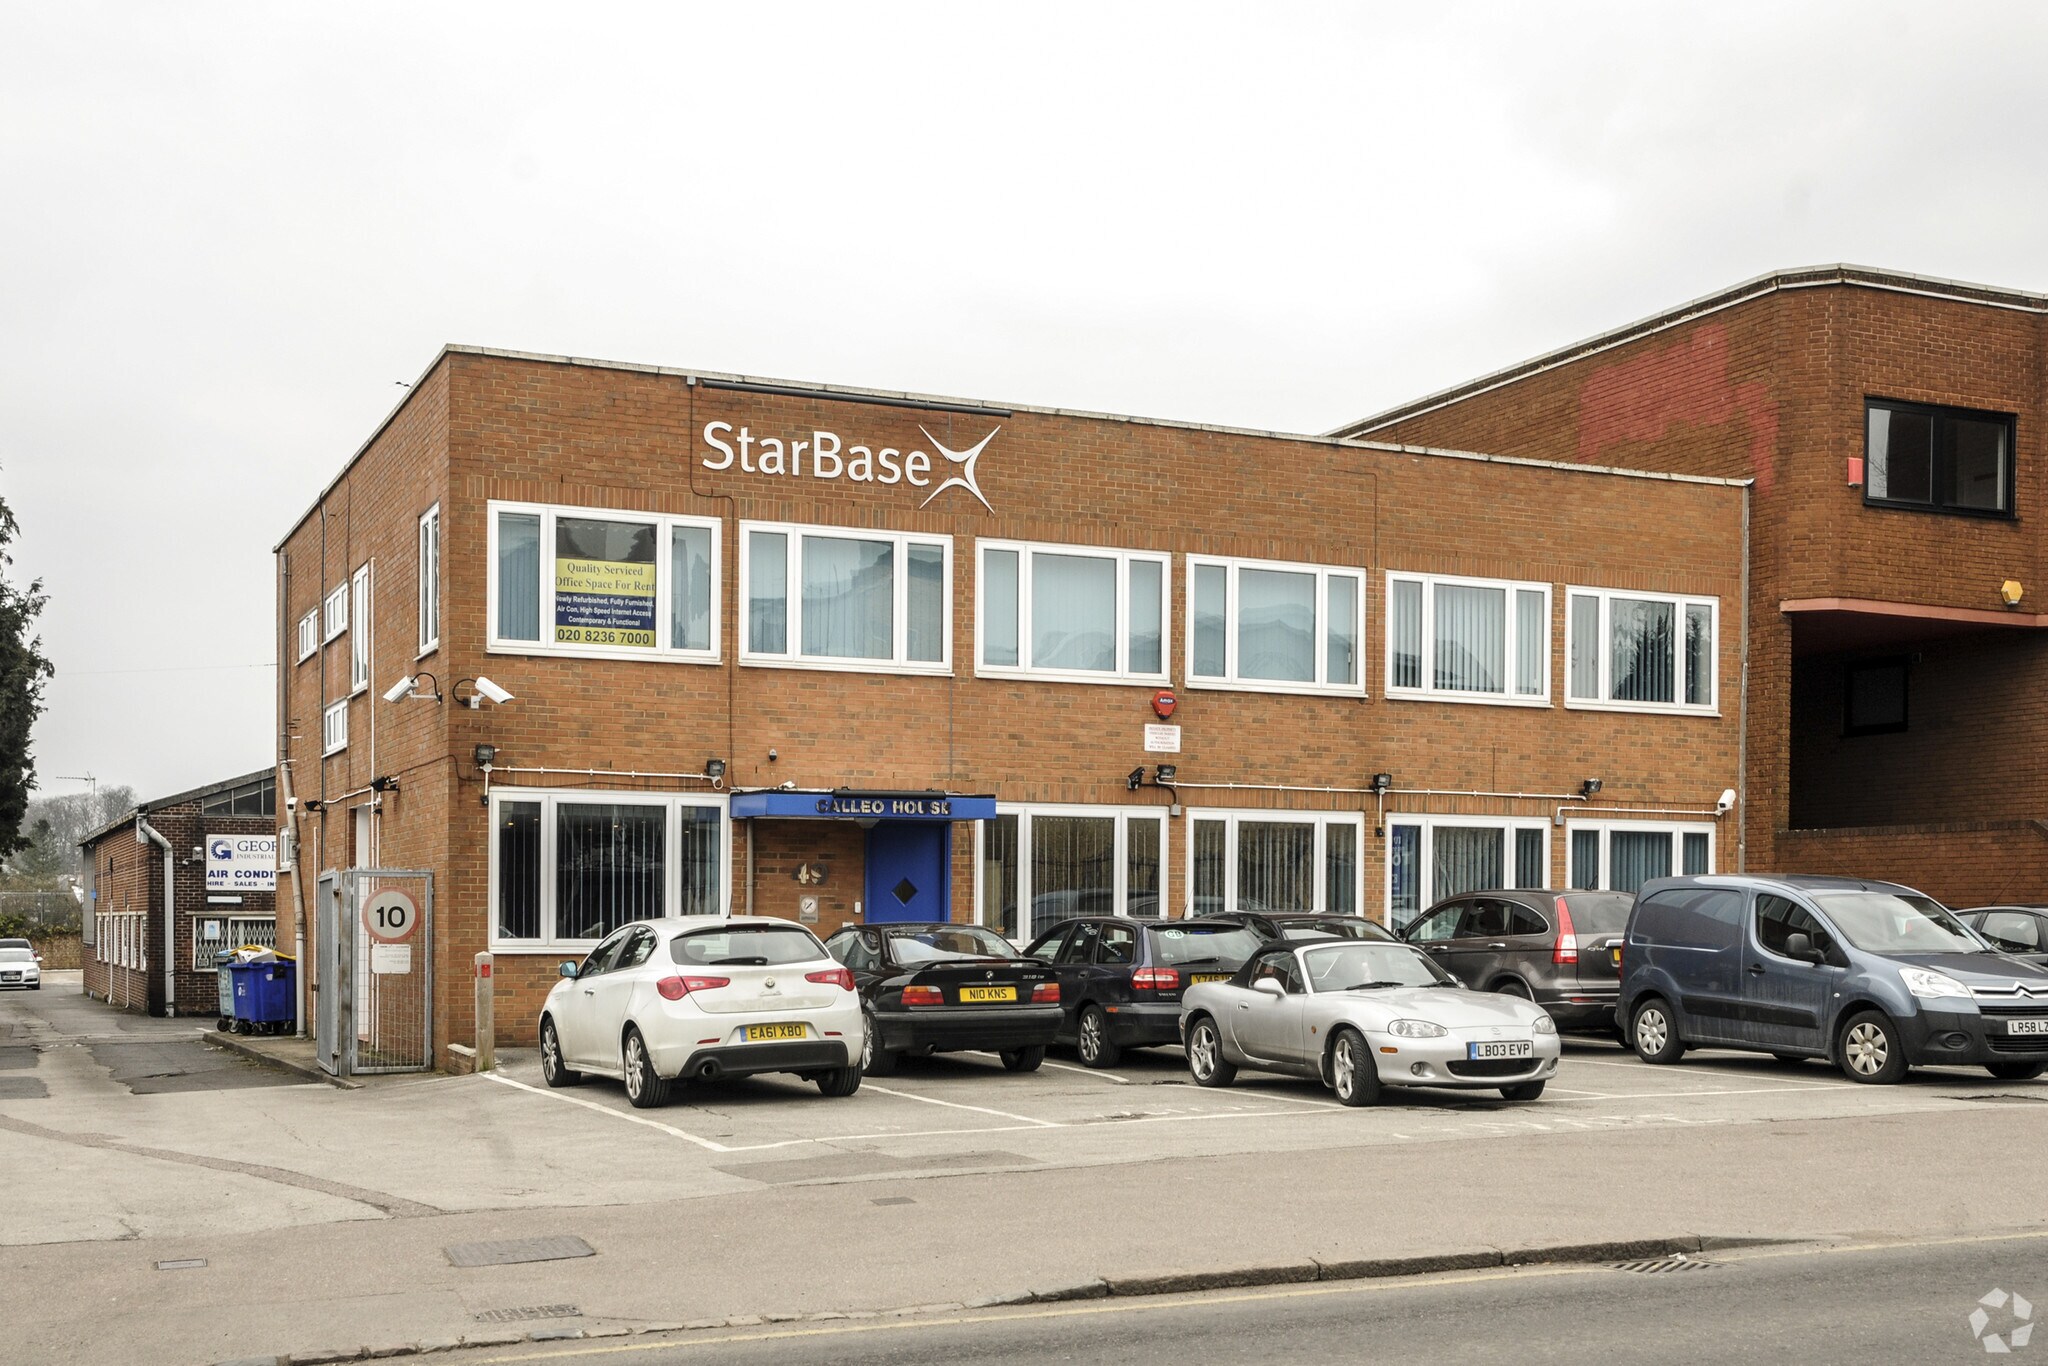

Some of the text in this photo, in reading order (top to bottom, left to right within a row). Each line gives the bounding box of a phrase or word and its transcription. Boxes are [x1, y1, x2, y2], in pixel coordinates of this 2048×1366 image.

[702, 420, 931, 487] StarBase
[567, 562, 643, 576] Quality Serviced
[556, 576, 655, 592] Office Space For Rent
[573, 596, 609, 605] Refurbished,
[610, 598, 624, 606] Fully
[580, 606, 592, 615] High
[594, 607, 610, 616] Speed
[632, 609, 652, 617] Access
[568, 616, 606, 626] Contemporary
[612, 618, 640, 626] Functional
[558, 628, 650, 644] 020 8236 7000
[208, 870, 228, 878] AIR
[376, 906, 406, 928] 10
[988, 988, 1008, 999] KNS
[750, 1026, 777, 1039] EA61
[2012, 1022, 2036, 1033] LR58
[1478, 1043, 1530, 1057] LB03 EVP
